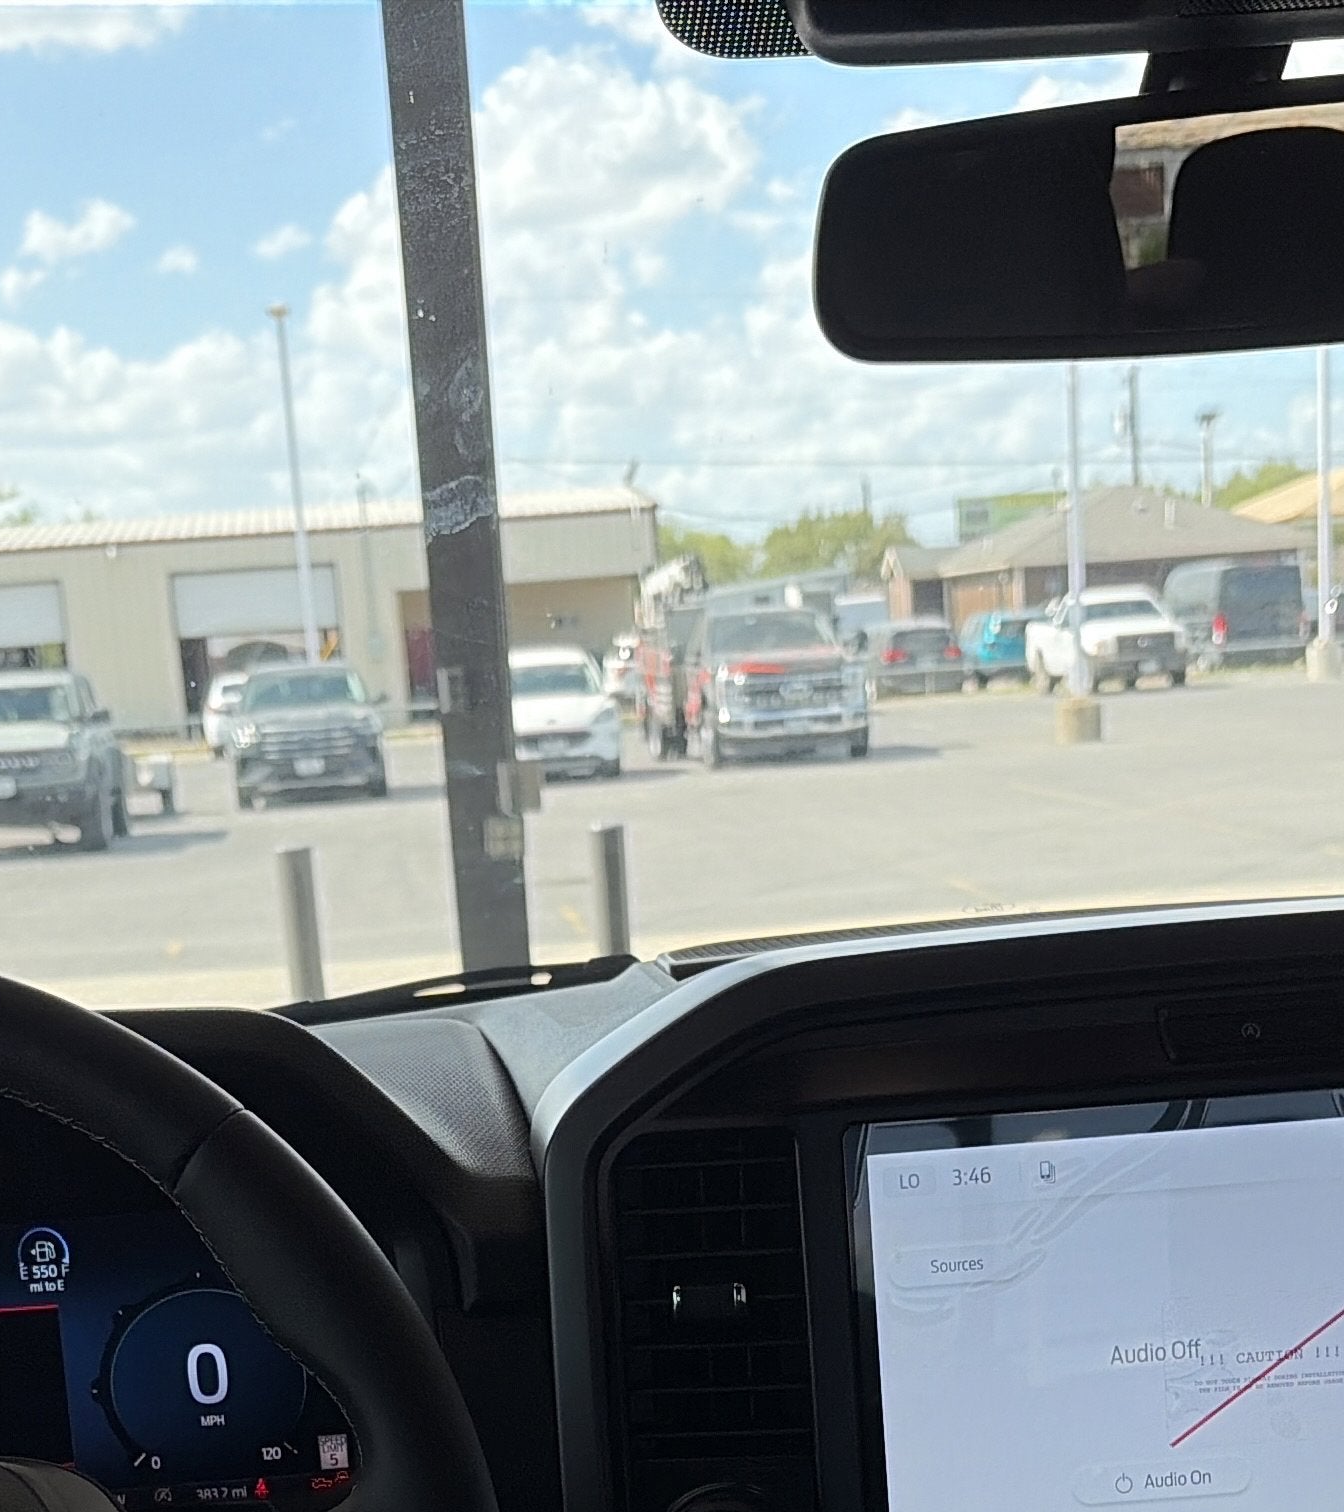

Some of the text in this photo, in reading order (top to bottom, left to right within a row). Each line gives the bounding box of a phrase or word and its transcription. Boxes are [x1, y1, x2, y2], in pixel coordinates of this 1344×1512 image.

[899, 1173, 920, 1190] LO
[952, 1166, 992, 1186] 3:46
[20, 1262, 70, 1280] E 550 F
[930, 1257, 984, 1274] Sources
[29, 1281, 43, 1293] mi
[1111, 1339, 1202, 1365] Audio Off
[187, 1343, 228, 1404] 0
[200, 1414, 225, 1427] MPH
[318, 1435, 346, 1446] SPEED
[261, 1446, 282, 1461] 120
[330, 1453, 339, 1466] 5
[151, 1457, 161, 1469] 0
[1144, 1470, 1212, 1489] Audio On
[231, 1485, 247, 1499] mi
